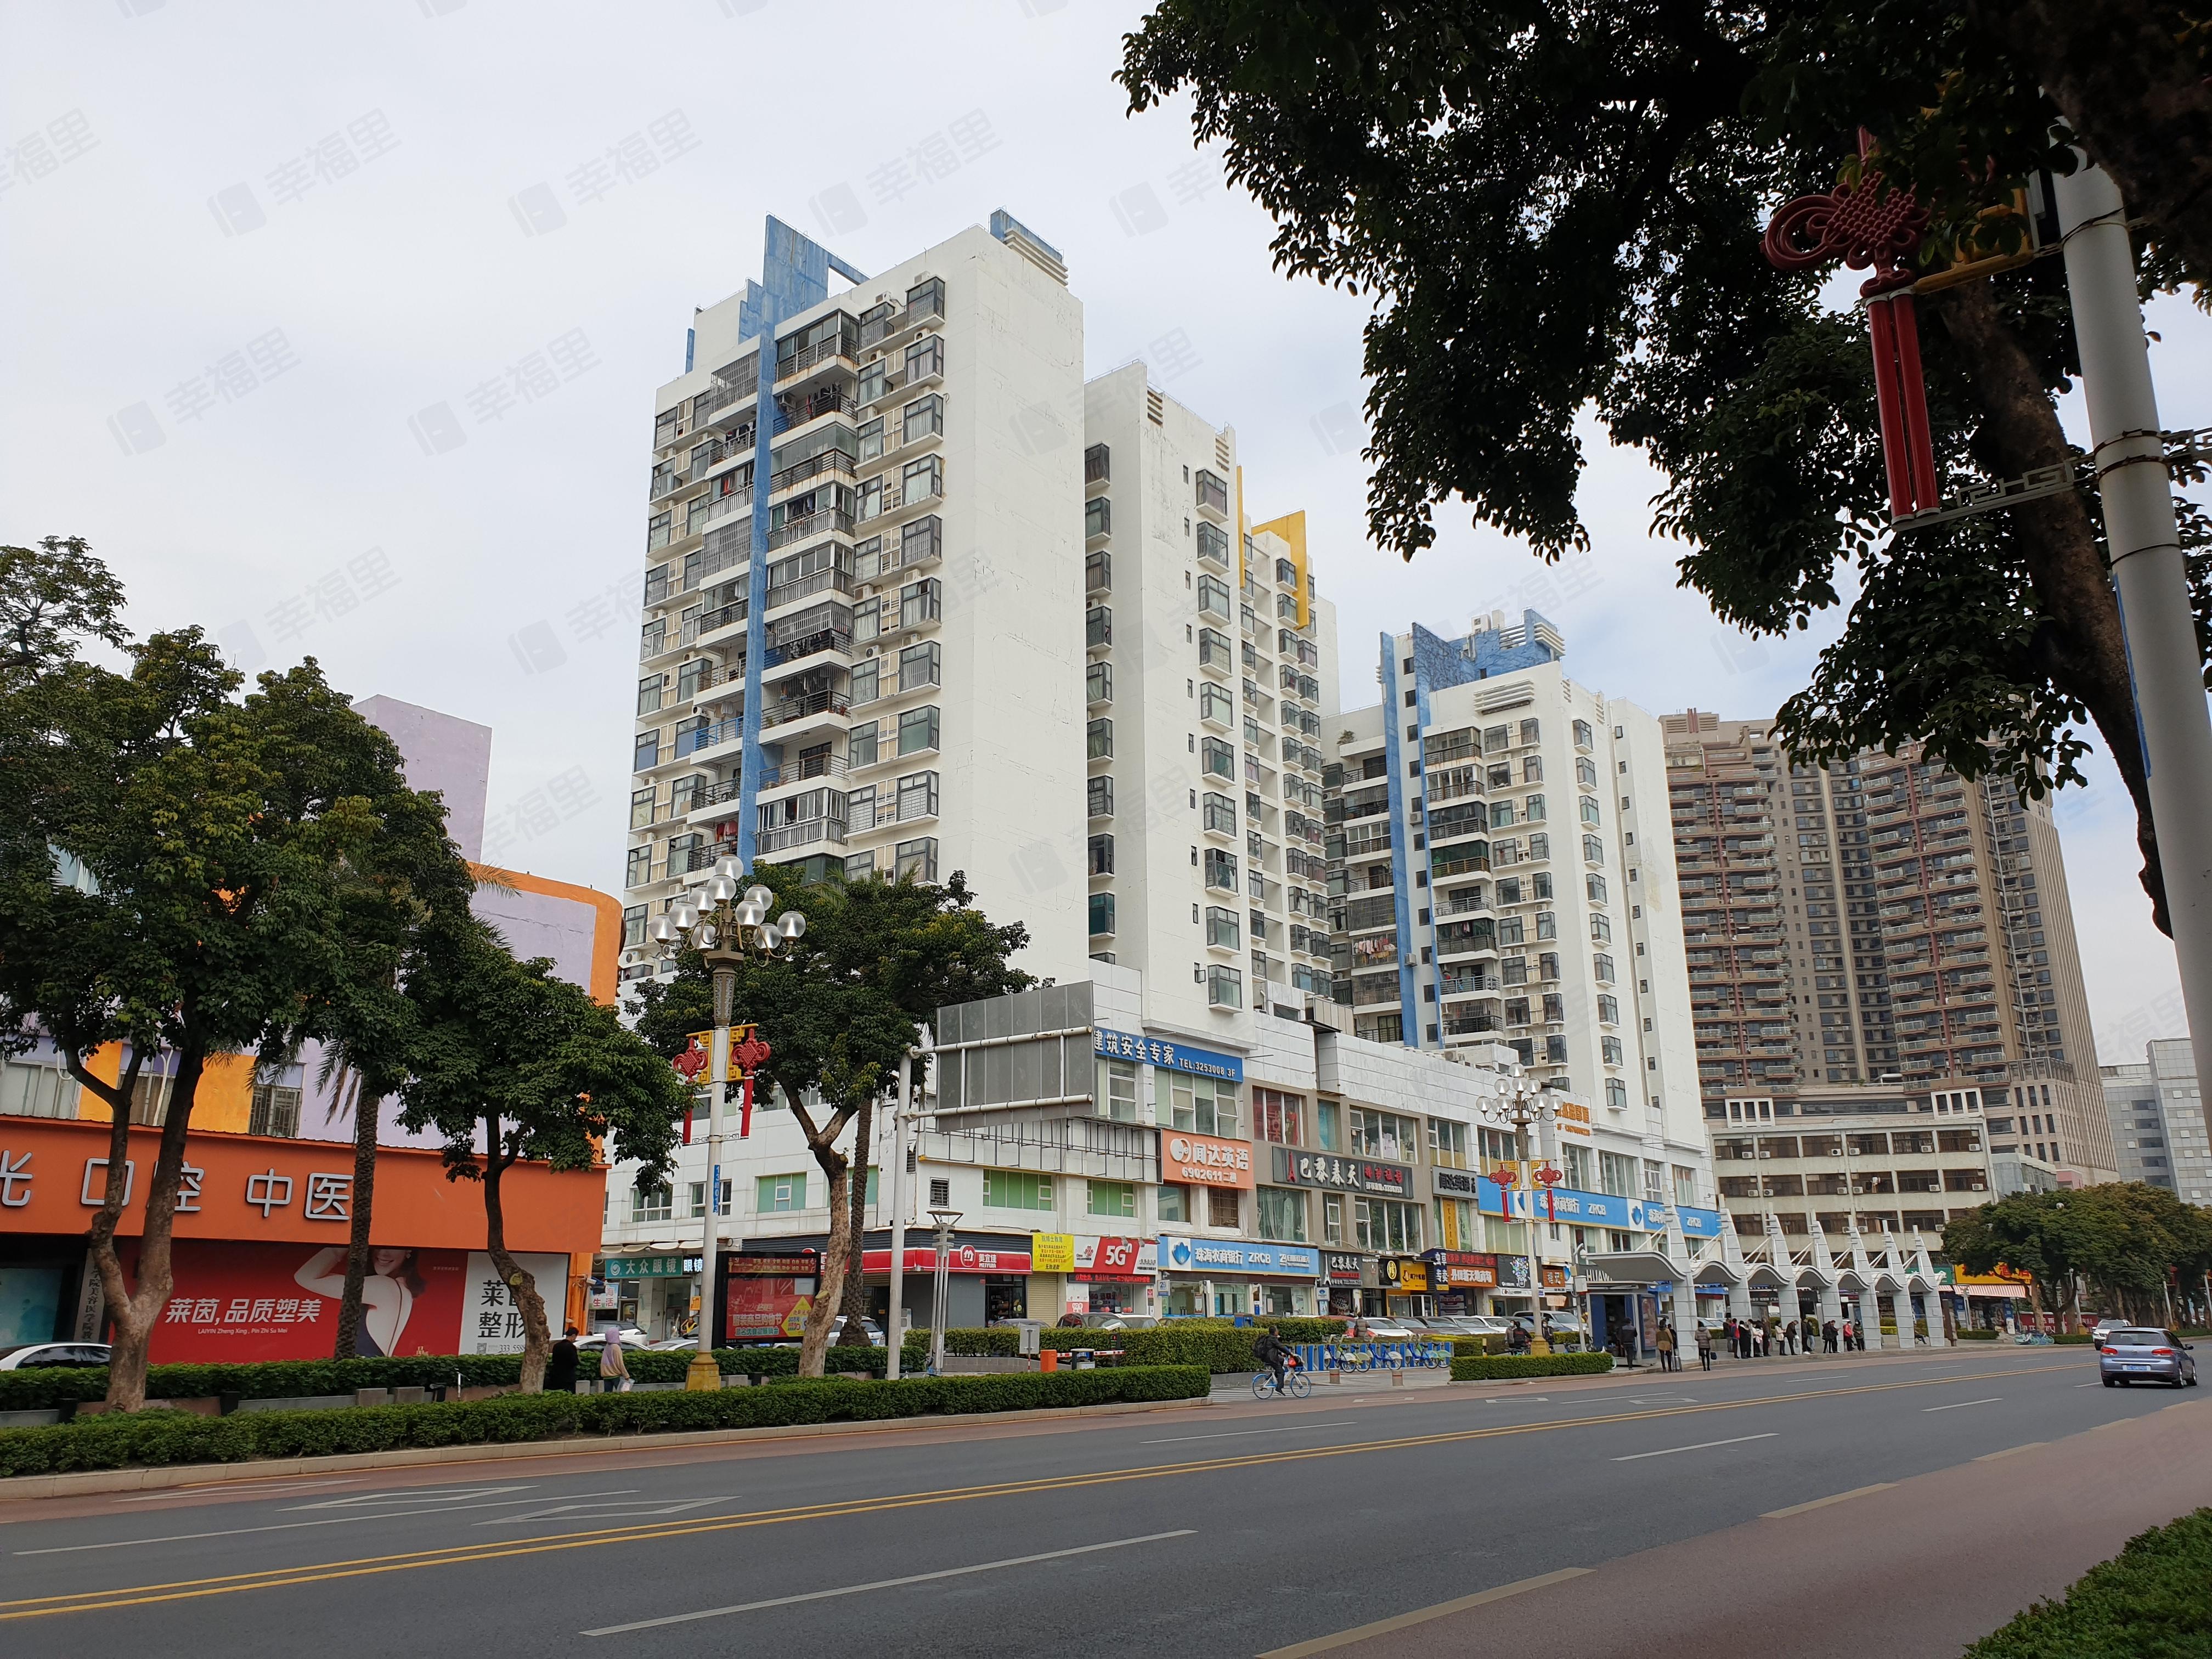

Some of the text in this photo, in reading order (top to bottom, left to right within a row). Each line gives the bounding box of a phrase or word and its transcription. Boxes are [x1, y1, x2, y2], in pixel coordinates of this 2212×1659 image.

[1094, 1030, 1235, 1077] 建筑安全专家 TEL:3253008 3F
[1193, 1142, 1249, 1170] 闻达英语
[1300, 1156, 1361, 1187] 巴黎春天
[246, 1168, 354, 1221] 中医
[1538, 1194, 1606, 1216] 珠农商银行 ZRCB
[626, 1258, 676, 1274] 大众眼镜
[684, 1259, 703, 1272] 眼镜
[979, 1254, 997, 1263] 美宜佳
[1195, 1248, 1243, 1265] 珠海农商银行
[1248, 1252, 1271, 1264] ZRCB
[1331, 1255, 1360, 1270] 巴黎春天
[593, 1297, 614, 1307] 生活
[477, 1312, 526, 1339] 整形
